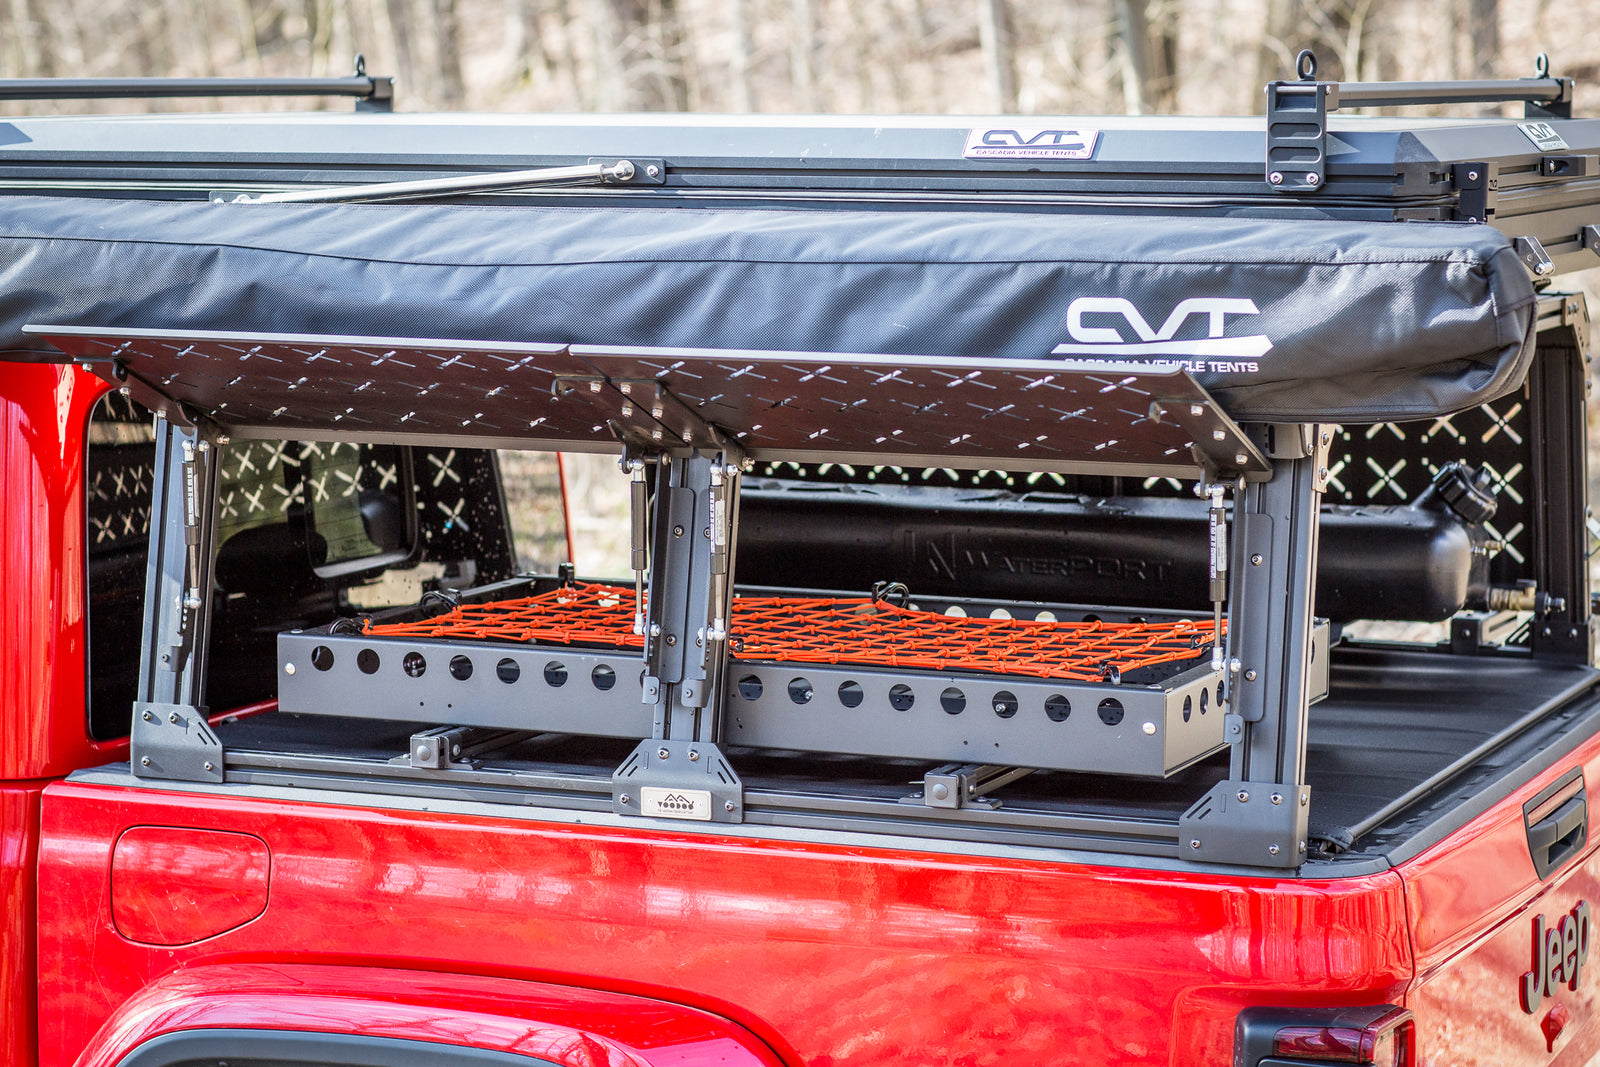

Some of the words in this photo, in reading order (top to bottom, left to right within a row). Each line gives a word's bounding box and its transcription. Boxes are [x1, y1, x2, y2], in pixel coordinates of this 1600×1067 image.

[981, 129, 1080, 145] CVT
[1066, 297, 1261, 343] CVT
[1207, 361, 1260, 373] TENTS
[657, 801, 694, 810] VOODOO
[1519, 900, 1590, 1015] Jeep
